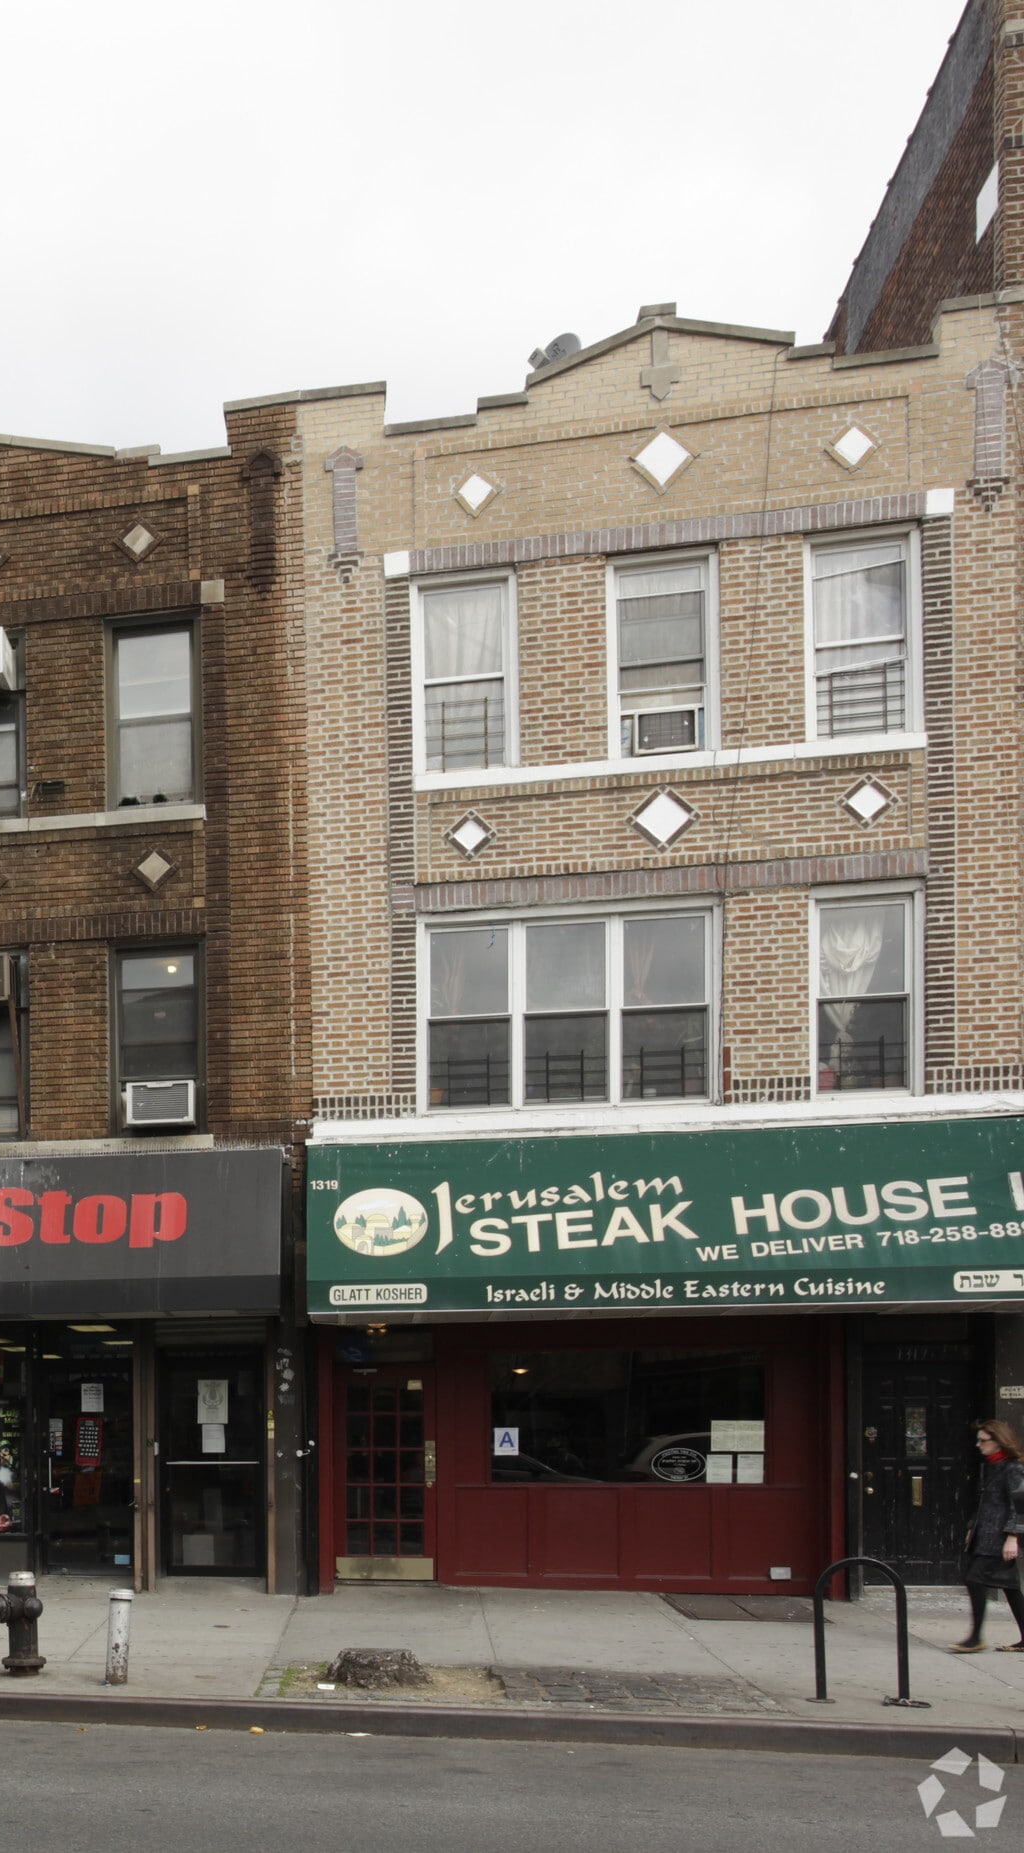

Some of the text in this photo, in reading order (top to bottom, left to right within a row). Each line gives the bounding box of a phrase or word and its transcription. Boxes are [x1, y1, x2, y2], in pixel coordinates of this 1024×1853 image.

[310, 1180, 338, 1190] 1319
[431, 1171, 684, 1255] Jerusalem
[470, 1201, 699, 1257] STEAK
[731, 1176, 978, 1235] HOUSE
[696, 1221, 1024, 1262] WE DELIVER 718-258-88
[486, 1277, 886, 1302] Israeli & Middle Eastern Cuisine
[960, 1274, 1000, 1288] שבת
[334, 1287, 423, 1302] GLATT KOSHER
[499, 1432, 514, 1447] A
